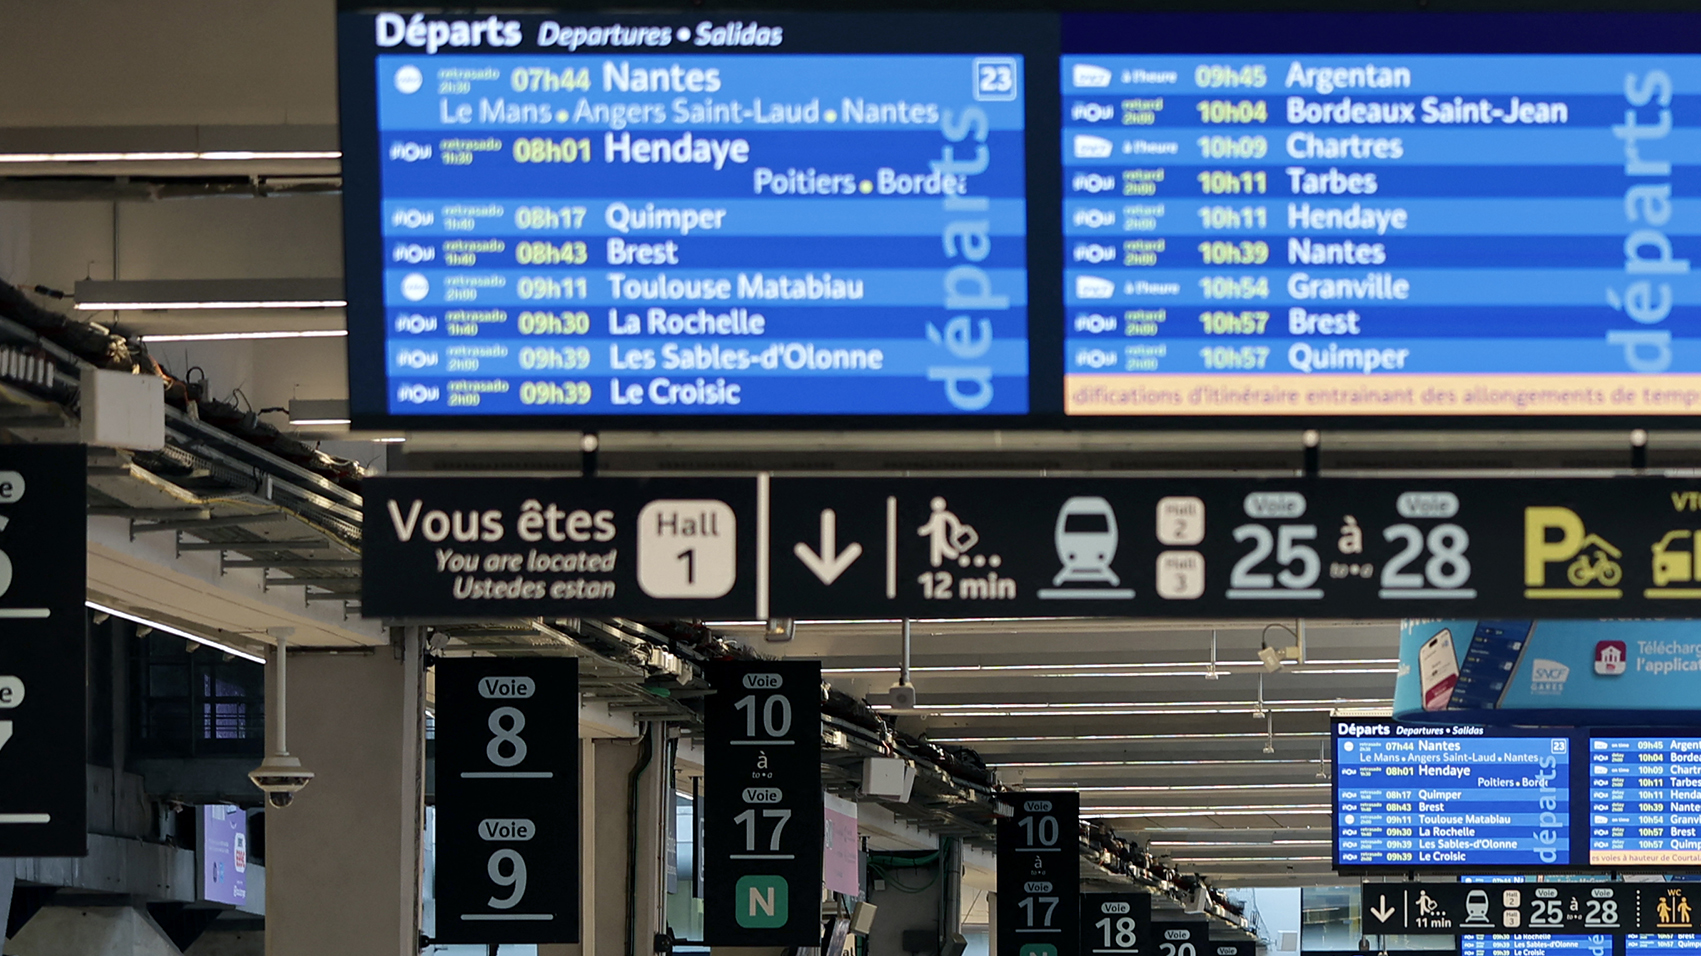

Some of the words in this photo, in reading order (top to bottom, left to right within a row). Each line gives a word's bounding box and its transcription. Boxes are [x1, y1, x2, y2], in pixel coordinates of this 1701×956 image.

[376, 13, 522, 54] Départs
[538, 22, 671, 50] Departures
[696, 22, 782, 45] Salidas
[512, 68, 591, 92] 07h44
[603, 61, 721, 92] Nantes
[980, 66, 1012, 91] 23
[1195, 66, 1266, 87] 09h45
[1285, 61, 1410, 94] Argentan
[440, 97, 472, 125] Le
[479, 97, 553, 125] Mans
[574, 97, 665, 131] Angers
[672, 97, 819, 125] Saint-Laud
[842, 97, 940, 125] Nantes
[1197, 101, 1268, 123] 10h04
[1287, 97, 1414, 123] Bordeaux
[1422, 97, 1568, 123] Saint-Jean
[513, 138, 590, 162] 08h01
[605, 132, 749, 170] Hendaye
[1198, 136, 1267, 158] 10h09
[1286, 132, 1403, 158] Chartres
[754, 168, 860, 194] Poitiers
[515, 207, 586, 229] 08h17
[606, 203, 726, 234] Quimper
[1606, 69, 1690, 372] départs
[925, 105, 1009, 411] départs
[518, 278, 586, 299] 09h11
[608, 273, 731, 299] Toulouse
[738, 273, 863, 299] Matabiau
[520, 347, 590, 369] 09h39
[610, 344, 656, 369] Les
[662, 343, 883, 369] Sables-d'Olonne
[520, 382, 591, 404] 09h39
[611, 378, 643, 404] Le
[649, 378, 740, 404] Croisic
[388, 500, 504, 541] Vous
[518, 500, 616, 541] êtes
[657, 512, 718, 536] Hall
[436, 549, 479, 572] You
[484, 554, 523, 572] are
[527, 549, 617, 572] located
[1231, 524, 1320, 590] 25
[1338, 516, 1362, 554] à
[1381, 524, 1473, 590] 28
[678, 549, 694, 584] 1
[454, 576, 546, 599] Ustedes
[550, 578, 615, 599] estan
[918, 572, 952, 599] 12
[960, 572, 1016, 599] min
[486, 680, 530, 698] Voie
[746, 674, 780, 688] Voie
[734, 694, 791, 737] 10
[487, 707, 527, 766] 8
[1338, 723, 1390, 738] Départs
[1396, 726, 1444, 736] Departures
[1452, 726, 1483, 734] Salidas
[1386, 742, 1414, 750] 07h44
[1419, 740, 1460, 751] Nantes
[757, 751, 767, 768] à
[746, 788, 780, 803] Voie
[486, 822, 530, 840] Voie
[734, 810, 791, 850] 17
[1419, 814, 1463, 824] Toulouse
[1466, 814, 1510, 824] Matabiau
[488, 849, 526, 909] 9
[750, 887, 774, 916] N
[1096, 917, 1136, 947] 18
[1416, 918, 1427, 928] 11
[1431, 918, 1451, 928] min
